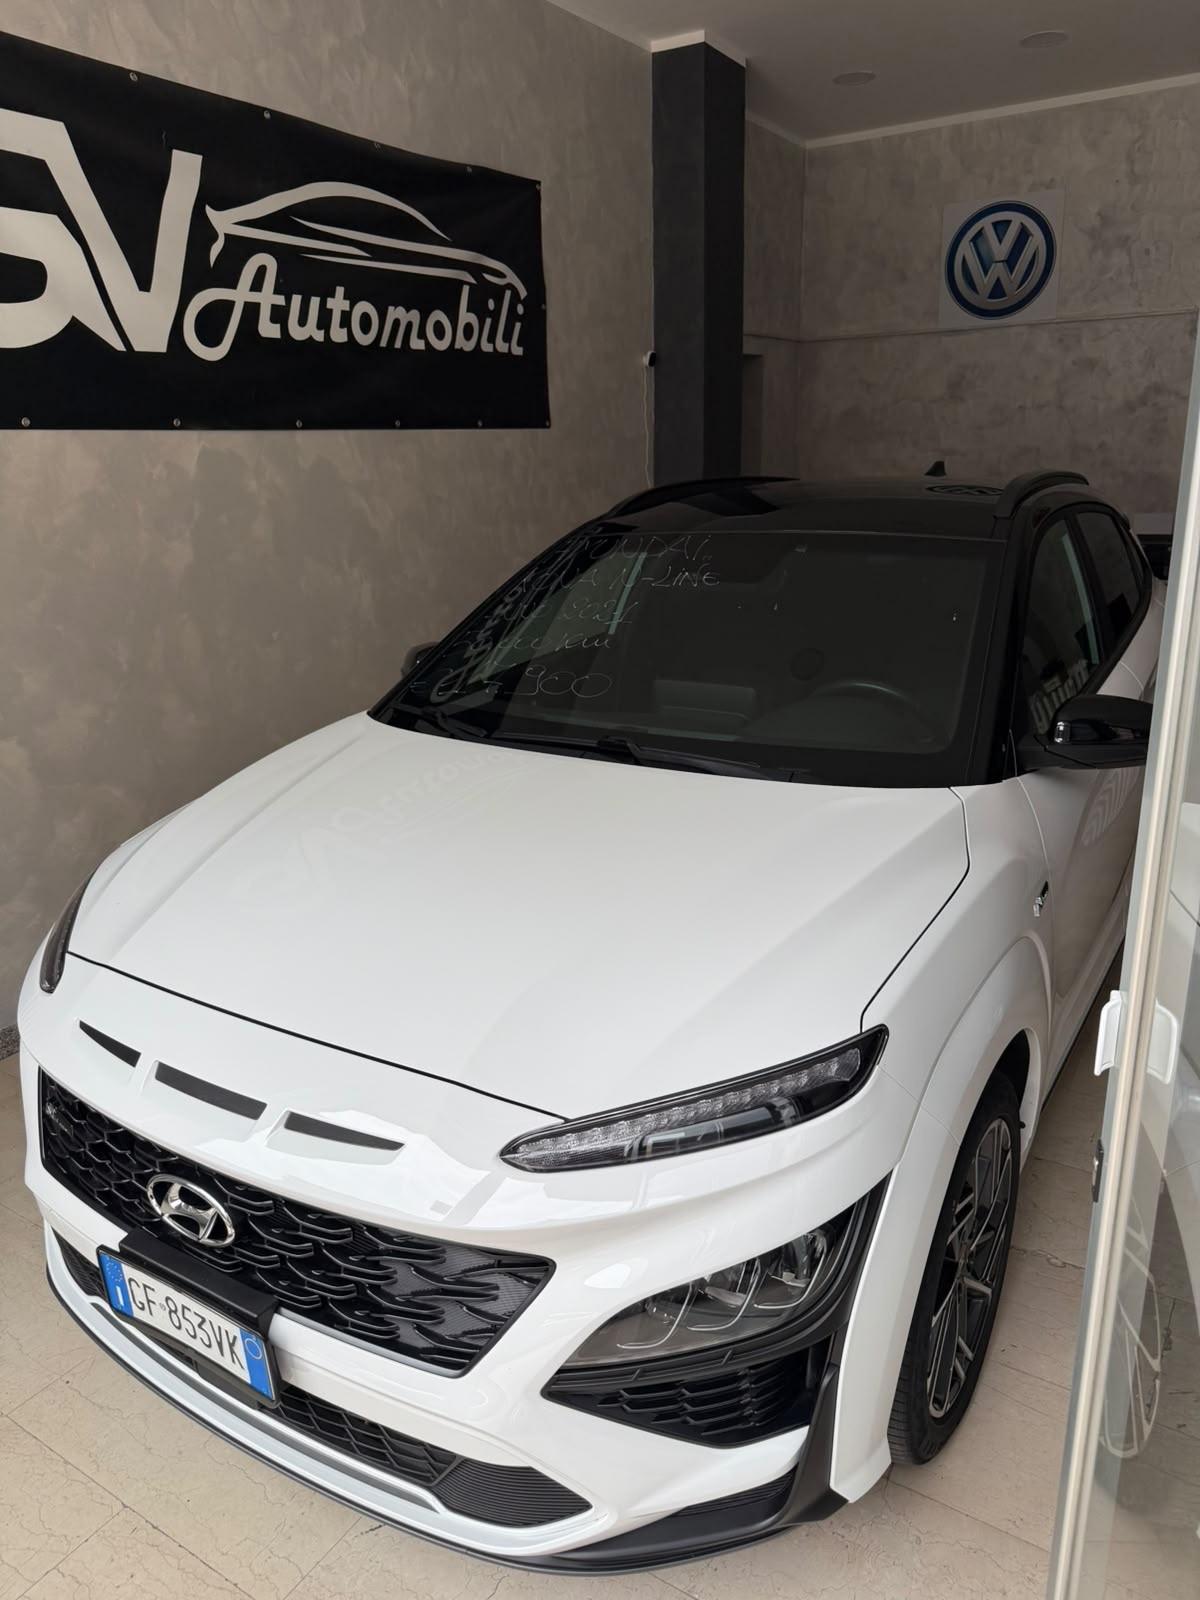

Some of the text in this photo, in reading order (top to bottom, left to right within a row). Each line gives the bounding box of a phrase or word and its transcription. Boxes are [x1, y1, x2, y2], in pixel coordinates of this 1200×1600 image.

[183, 252, 525, 362] Automobili
[127, 1276, 156, 1316] GF
[165, 1295, 246, 1370] 853VK
